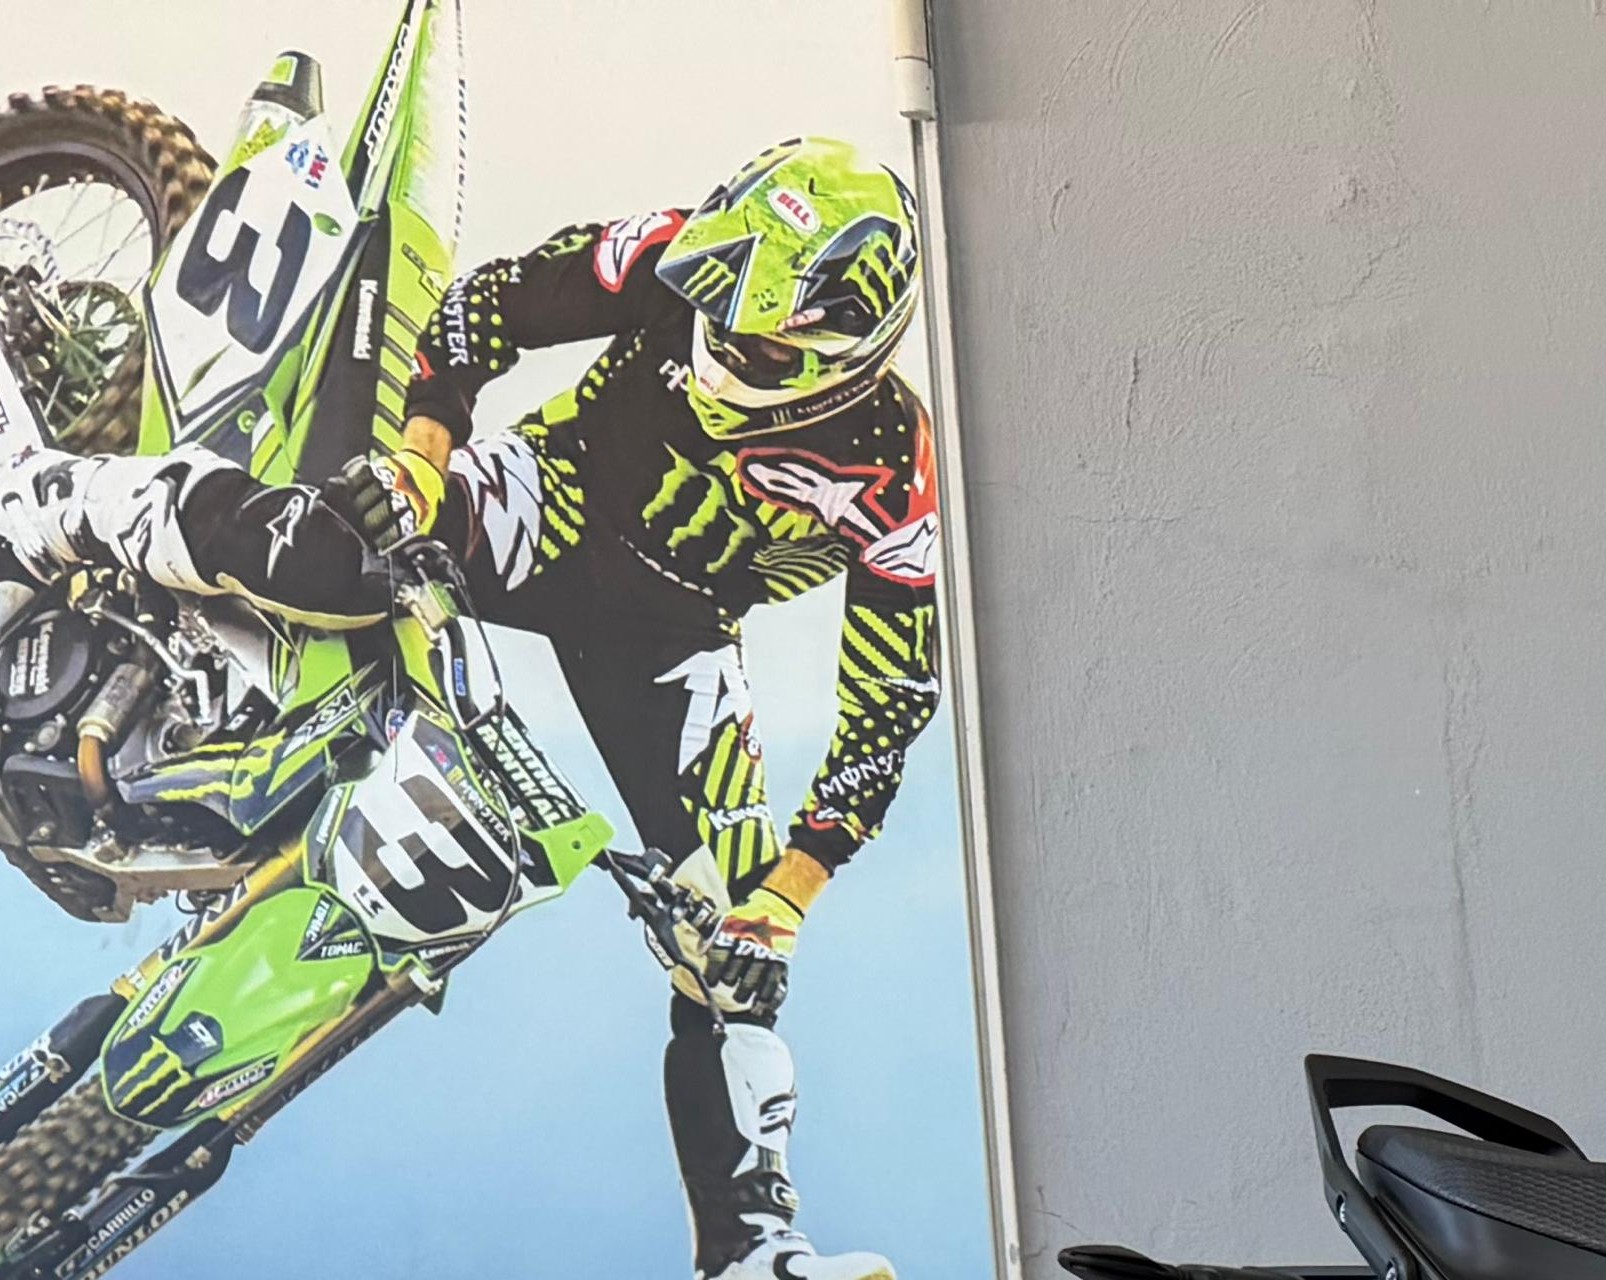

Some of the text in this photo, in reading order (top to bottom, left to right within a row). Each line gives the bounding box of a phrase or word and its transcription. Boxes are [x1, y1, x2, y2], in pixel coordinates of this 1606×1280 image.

[777, 192, 811, 226] BELL
[176, 167, 311, 353] 3
[475, 723, 561, 829] RENTHAL
[335, 773, 508, 935] 3
[320, 941, 364, 958] TOMAC
[87, 1188, 156, 1250] CARRILLO
